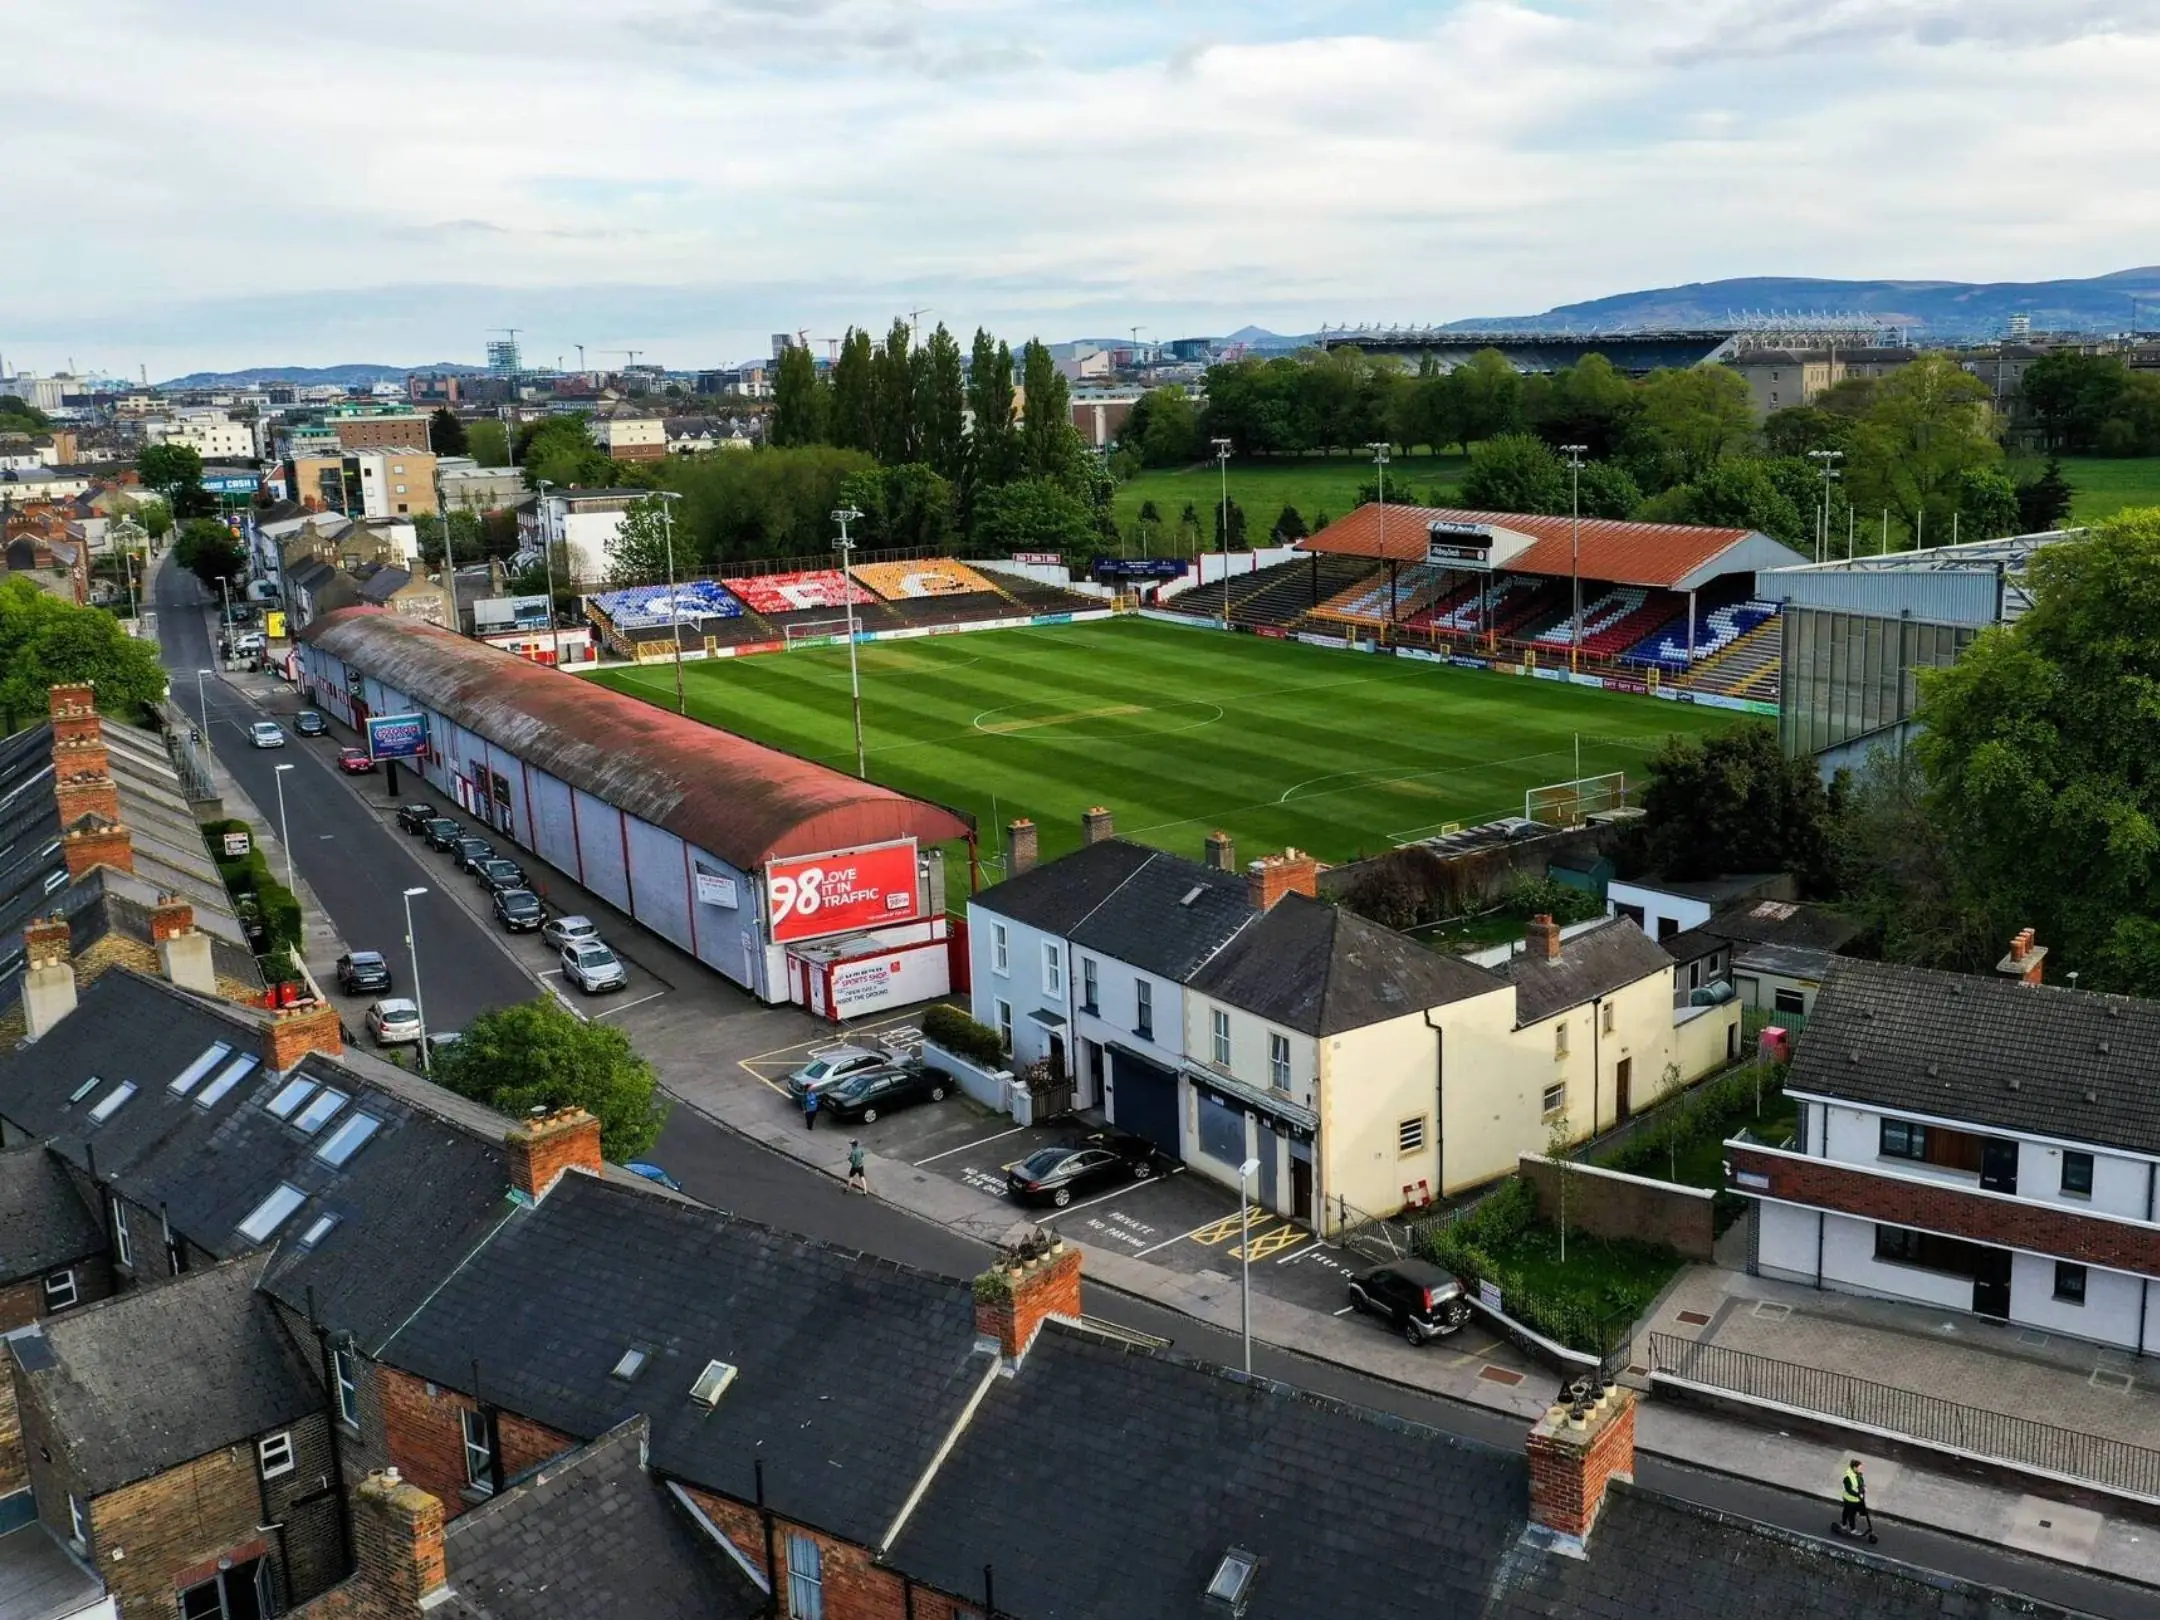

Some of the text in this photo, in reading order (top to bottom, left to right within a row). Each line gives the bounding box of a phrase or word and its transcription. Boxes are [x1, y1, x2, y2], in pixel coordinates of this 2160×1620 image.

[822, 868, 857, 886] LOVE
[770, 867, 823, 928] 98
[822, 882, 851, 896] IT IN
[822, 888, 880, 908] TRAFFIC
[841, 975, 868, 987] SPORTS
[869, 971, 888, 982] SHOP
[1086, 1218, 1147, 1248] NO PARKING
[1108, 1212, 1156, 1235] PRIVATE
[1310, 1252, 1339, 1267] KEEP
